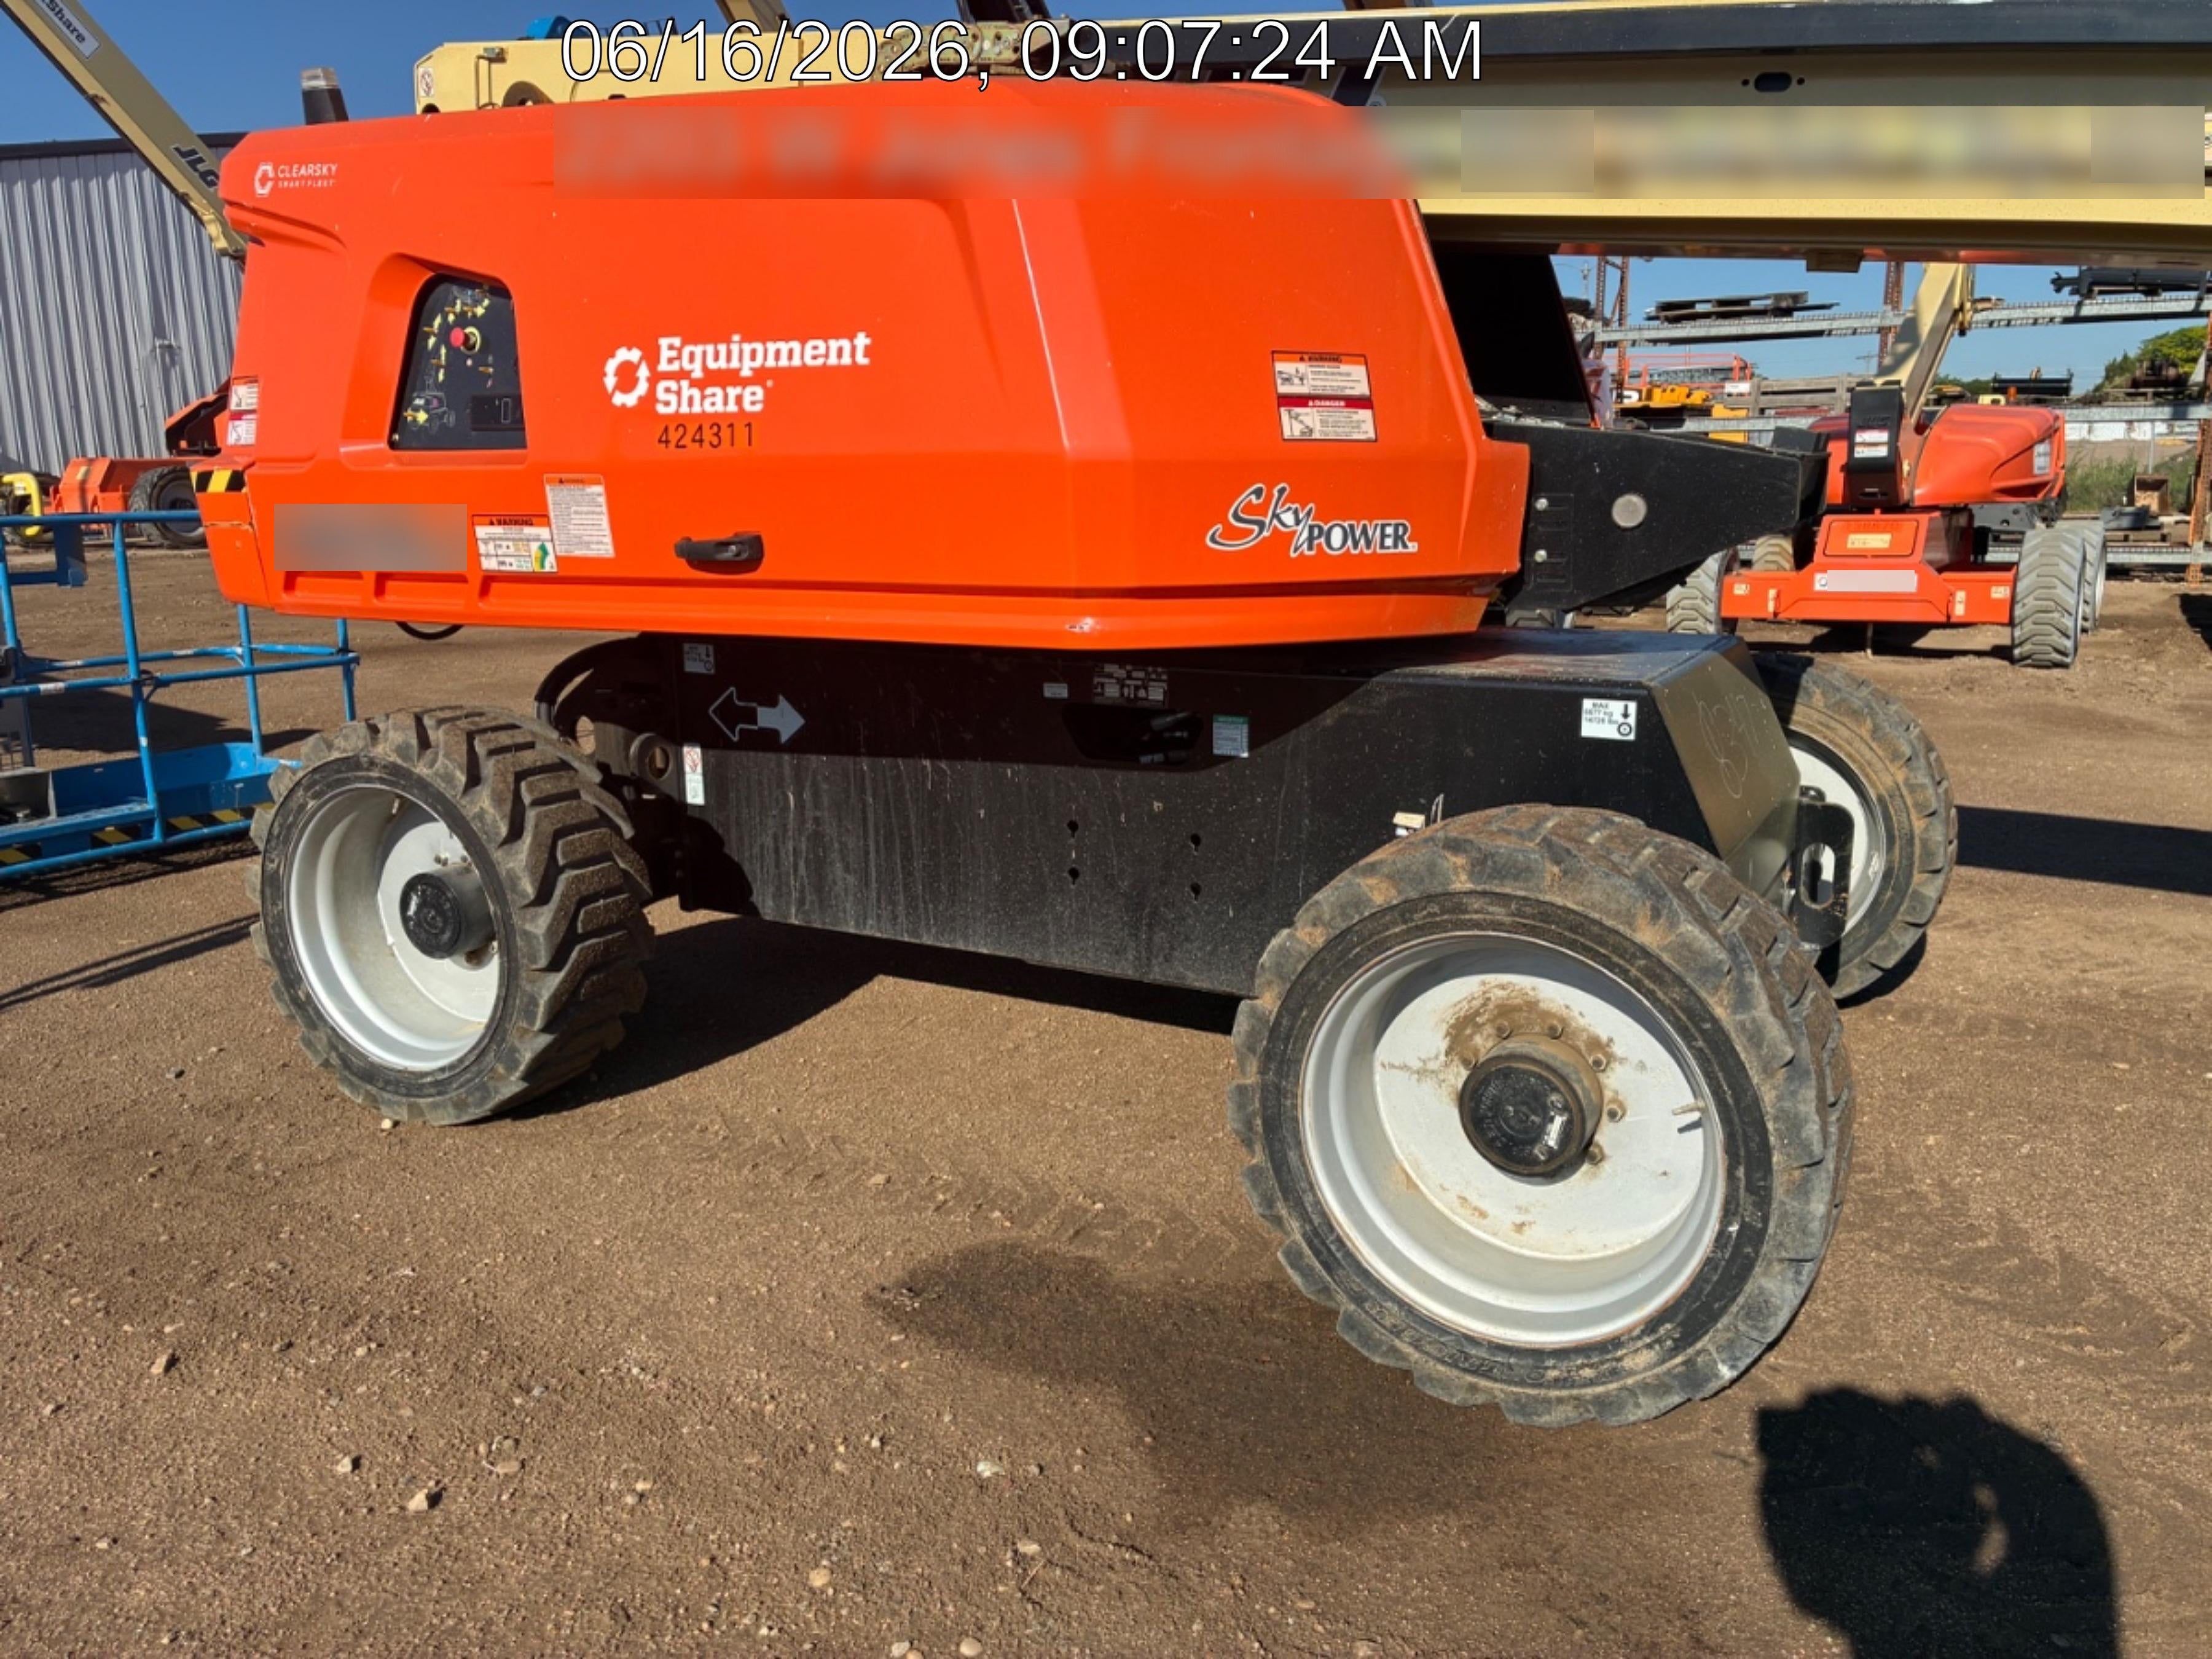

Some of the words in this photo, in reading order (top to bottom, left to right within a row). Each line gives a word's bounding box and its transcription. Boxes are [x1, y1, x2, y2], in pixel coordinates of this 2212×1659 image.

[172, 146, 219, 188] JLG
[278, 163, 337, 178] CLEARSKY
[657, 331, 871, 378] Equipment
[655, 380, 764, 414] Share
[657, 422, 754, 449] 424311
